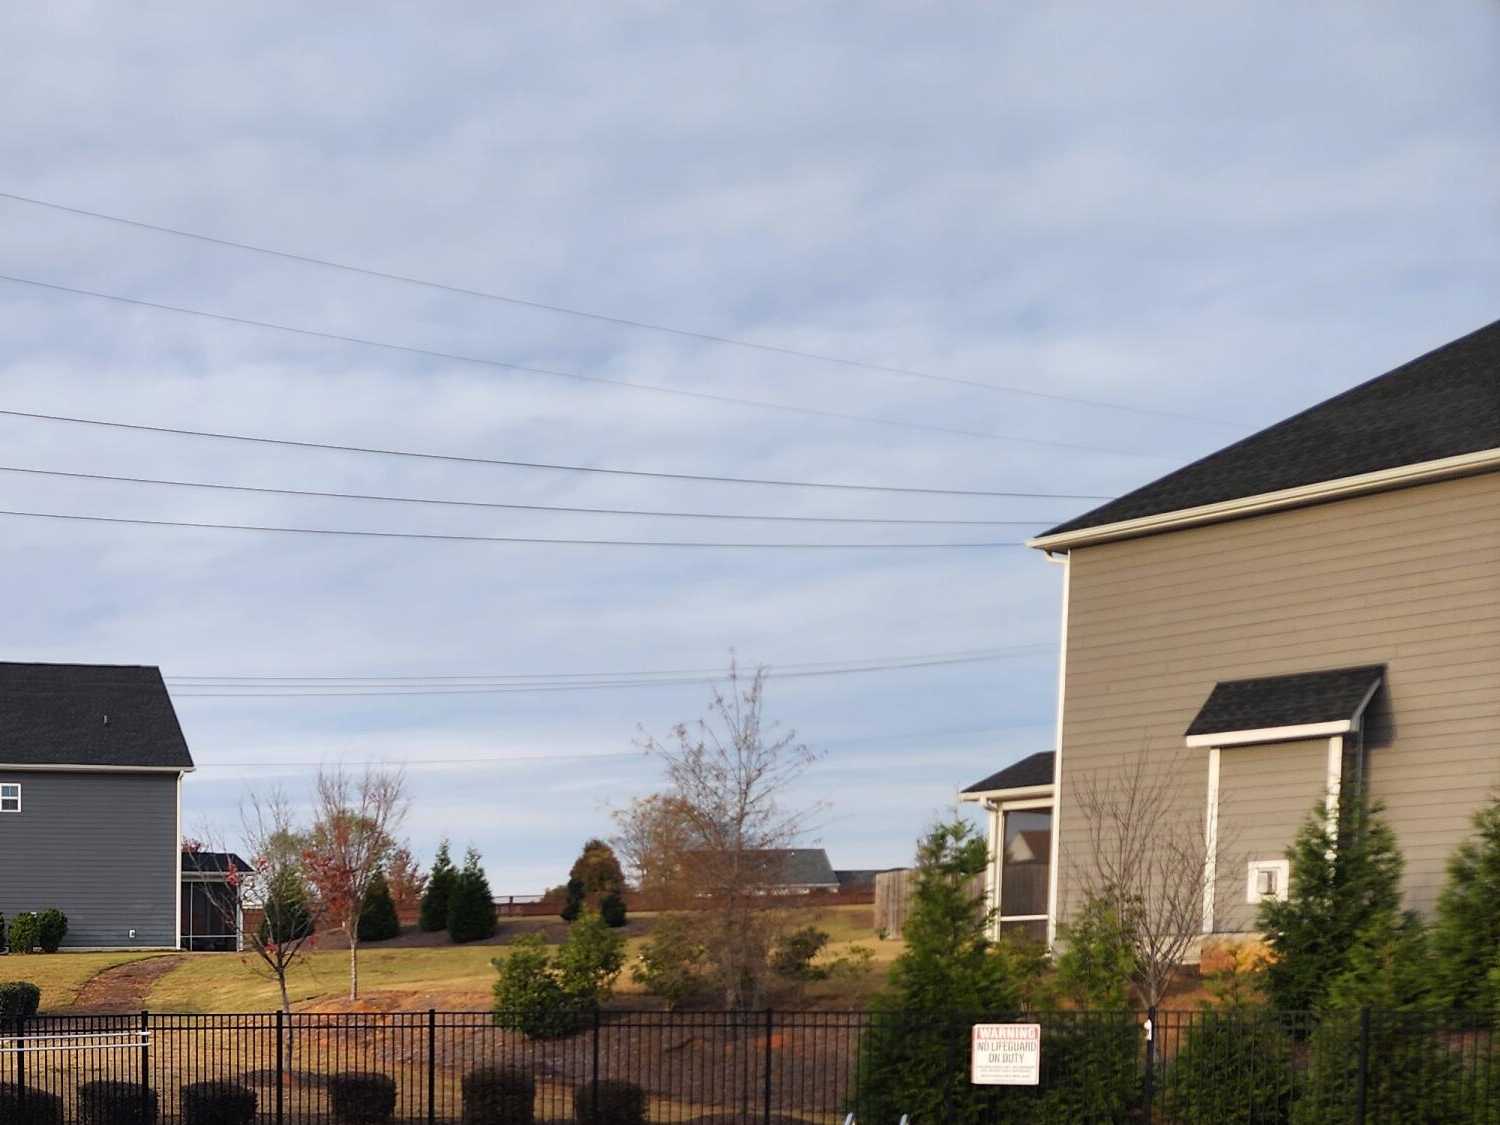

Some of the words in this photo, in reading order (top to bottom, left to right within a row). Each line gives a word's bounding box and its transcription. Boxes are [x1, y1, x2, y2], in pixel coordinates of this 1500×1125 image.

[980, 1028, 1034, 1039] WARNING
[978, 1041, 989, 1051] NO
[991, 1041, 1036, 1051] LIFEGUARD
[989, 1053, 1000, 1063] ON
[1002, 1053, 1024, 1063] DUTY
